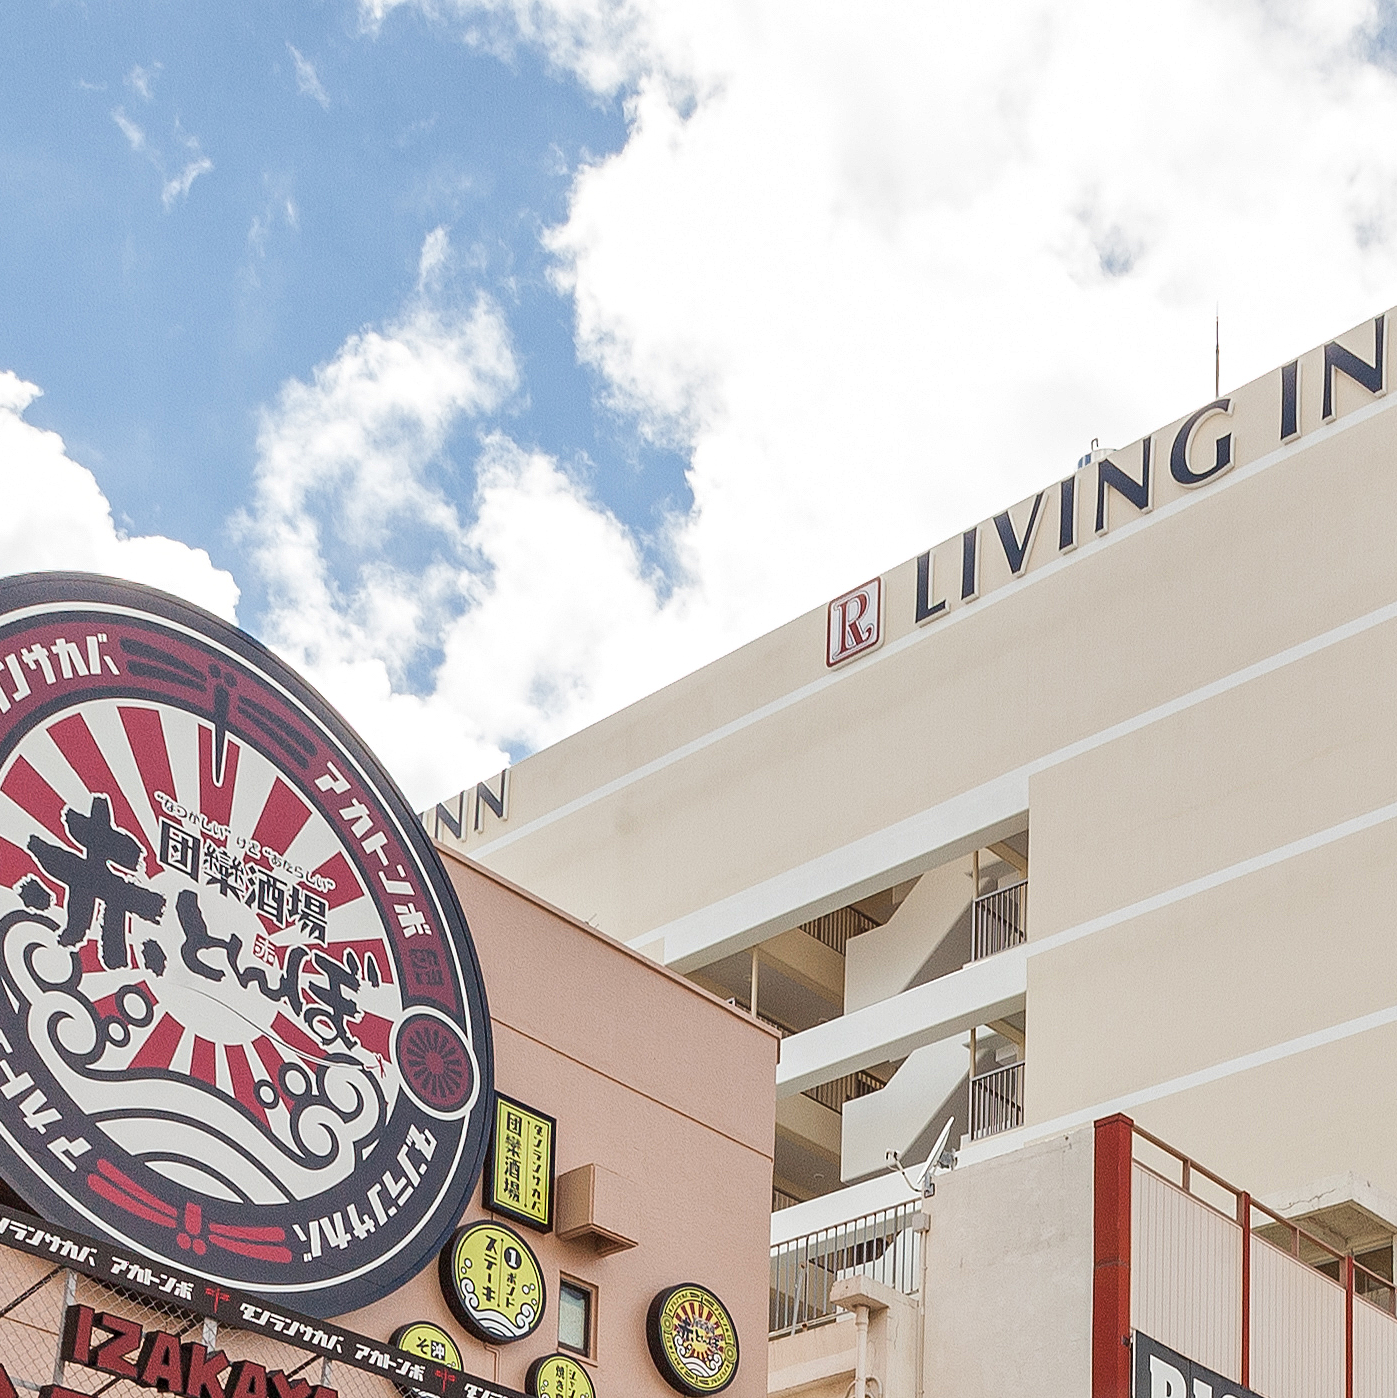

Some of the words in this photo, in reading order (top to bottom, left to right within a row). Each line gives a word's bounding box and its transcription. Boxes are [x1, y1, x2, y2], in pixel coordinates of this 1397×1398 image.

[915, 398, 1235, 626] LIVING
[316, 759, 430, 939] アカトンボ
[15, 792, 382, 1046] 赤とんぼ
[296, 1125, 438, 1263] ダンランサカバ
[110, 1256, 195, 1301] アカトンボ
[483, 1235, 497, 1303] ステーキ
[239, 1302, 344, 1353] ダンランサカバ
[354, 1343, 425, 1383] アカトンボ
